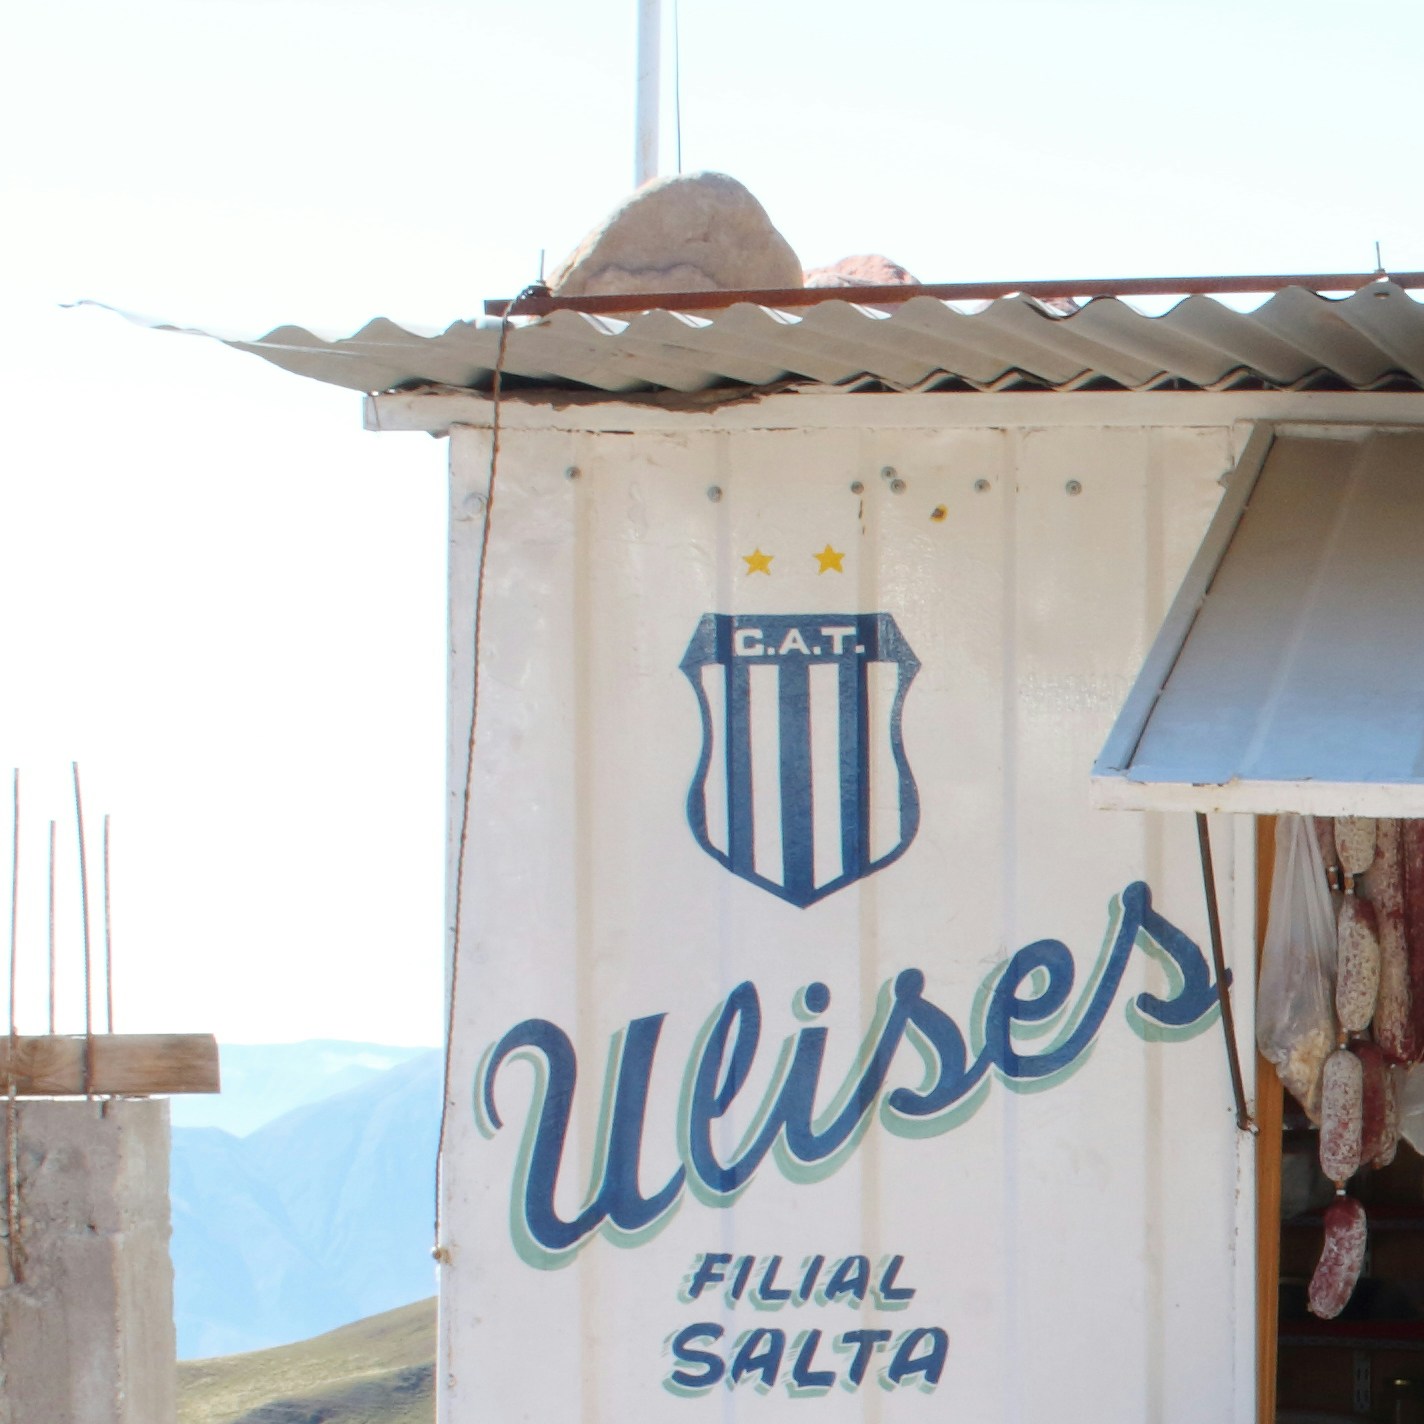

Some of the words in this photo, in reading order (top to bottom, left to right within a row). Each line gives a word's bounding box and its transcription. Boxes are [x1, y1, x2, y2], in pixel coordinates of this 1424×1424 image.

[733, 625, 866, 657] C.A.T.
[474, 880, 1232, 1270] Ulises
[678, 1252, 916, 1310] FILIAL
[662, 1322, 950, 1398] SALTA
